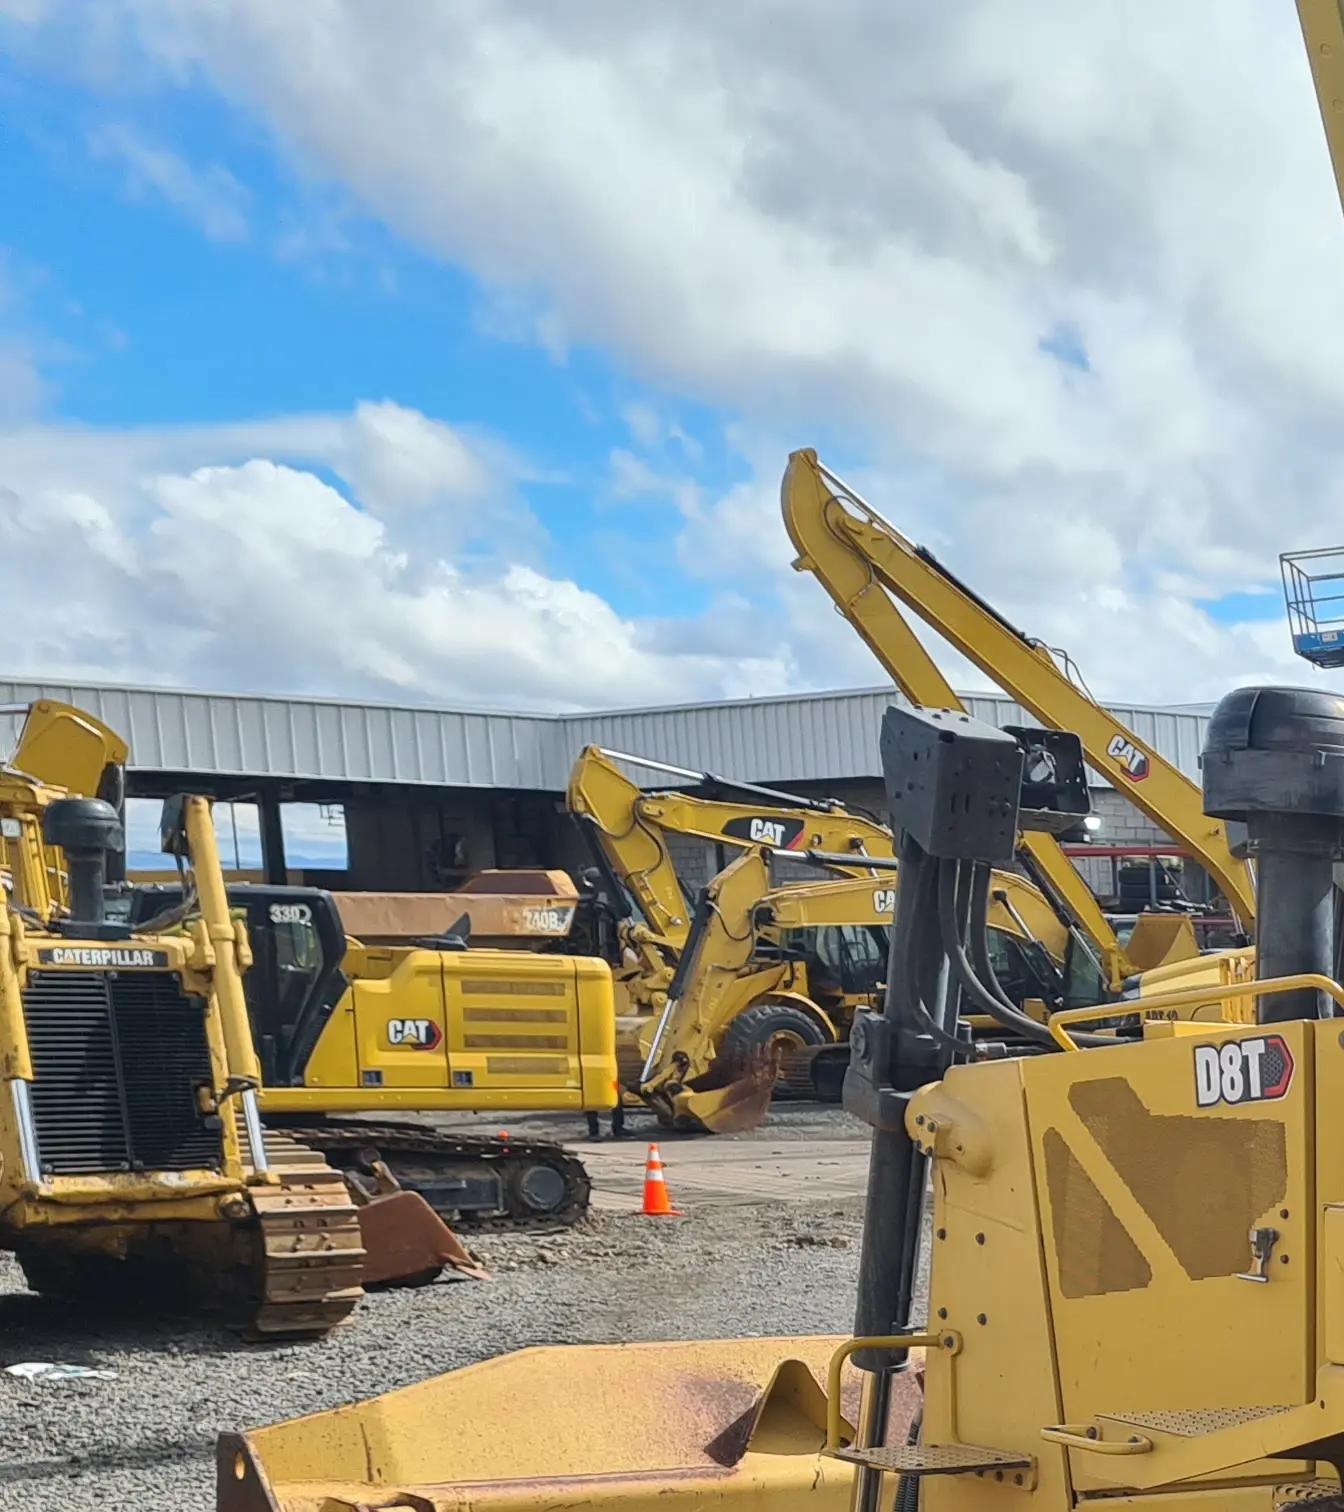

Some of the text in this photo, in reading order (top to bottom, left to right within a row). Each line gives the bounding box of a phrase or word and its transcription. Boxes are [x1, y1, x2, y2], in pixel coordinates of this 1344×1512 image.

[1107, 735, 1146, 773] CAT
[750, 818, 786, 847] CAT
[873, 890, 895, 913] CA
[52, 947, 154, 966] CATERPILLAR
[388, 1019, 429, 1044] CAT
[1195, 1038, 1266, 1105] D8T
